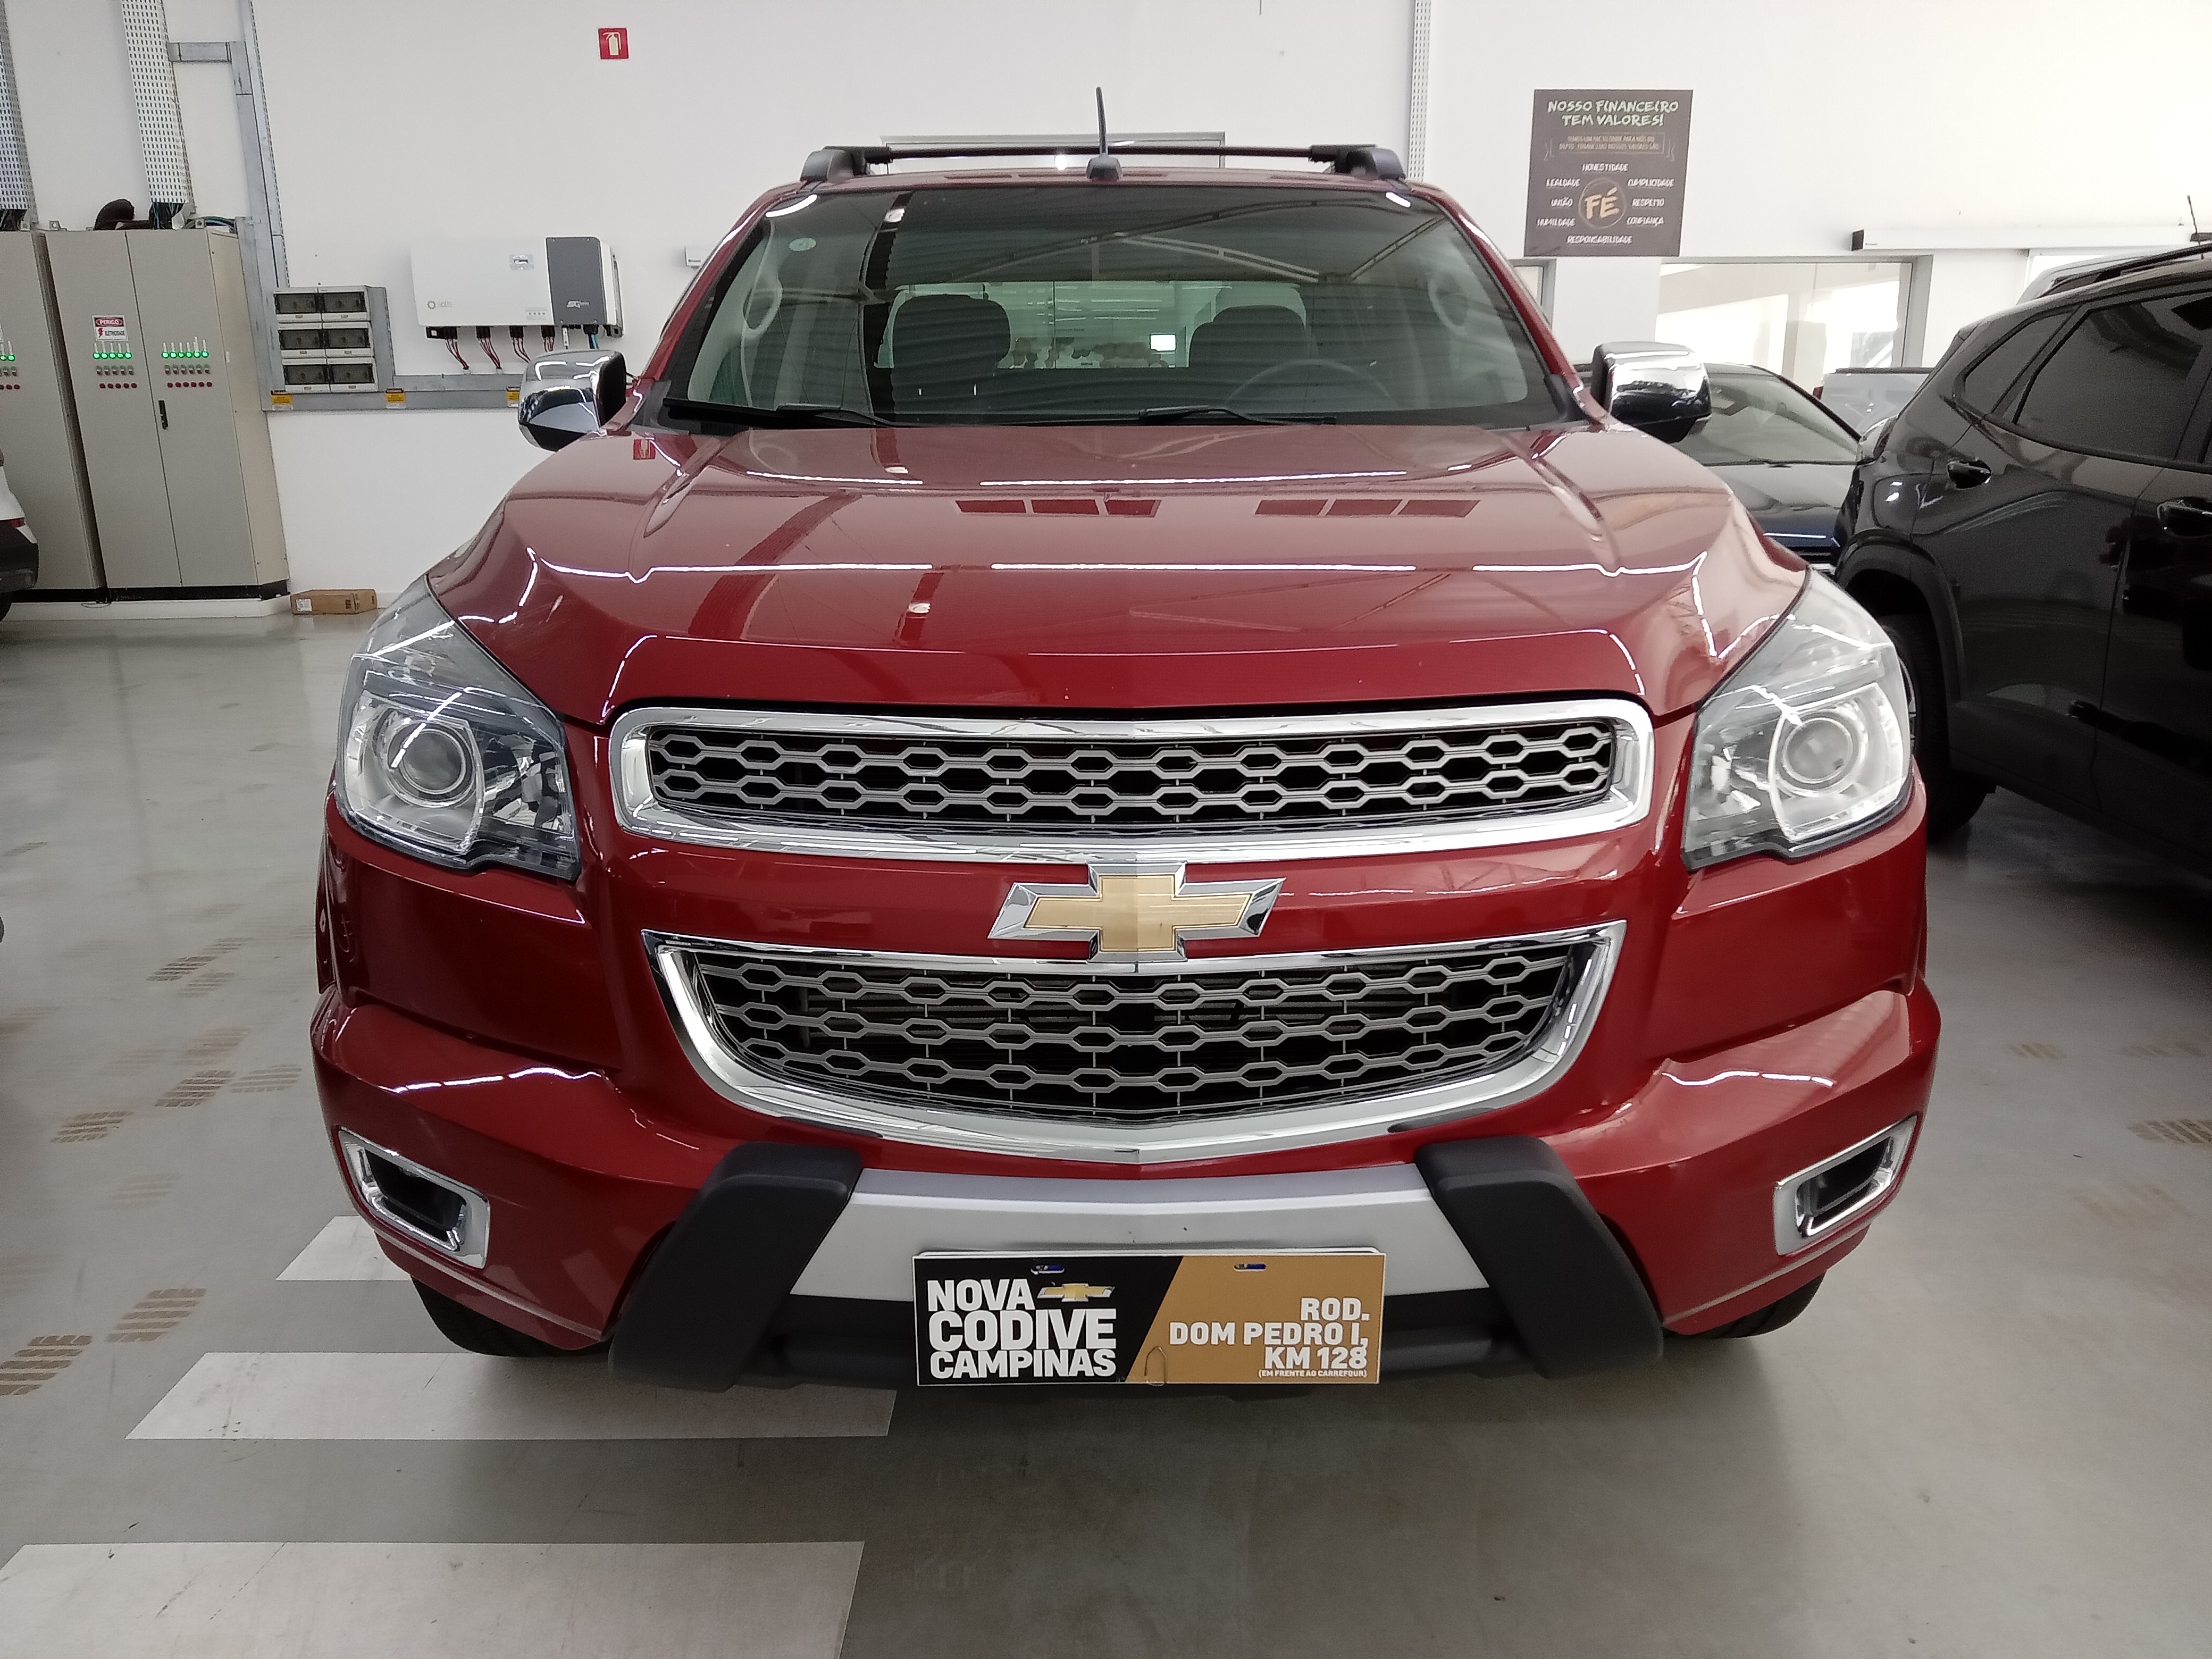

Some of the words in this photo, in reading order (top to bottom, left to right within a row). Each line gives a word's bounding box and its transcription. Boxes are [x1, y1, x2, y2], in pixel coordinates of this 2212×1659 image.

[1547, 100, 1593, 113] NOSSO
[1595, 100, 1679, 113] FINANCEIRO
[1561, 114, 1594, 126] TEM
[1596, 113, 1664, 127] VALORES!
[1581, 163, 1629, 172] HONESTIDADE
[1551, 197, 1573, 207] UNIÃO
[1584, 187, 1620, 220] FÉ
[1631, 198, 1665, 207] RESPEITO
[1626, 216, 1664, 227] CONFIANÇA
[1566, 235, 1633, 244] RESPONSABILIDADE
[927, 1278, 1036, 1312] NOVA
[1300, 1297, 1370, 1321] ROD.
[929, 1308, 1117, 1351] CODIVE
[1169, 1322, 1236, 1345] DOM
[1243, 1322, 1344, 1345] PEDRO
[1350, 1322, 1369, 1349] I,
[930, 1348, 1117, 1379] CAMPINAS
[1264, 1346, 1311, 1369] KM
[1316, 1346, 1368, 1369] 128
[1258, 1370, 1274, 1378] (EM
[1318, 1370, 1367, 1378] CARREFOUR)
